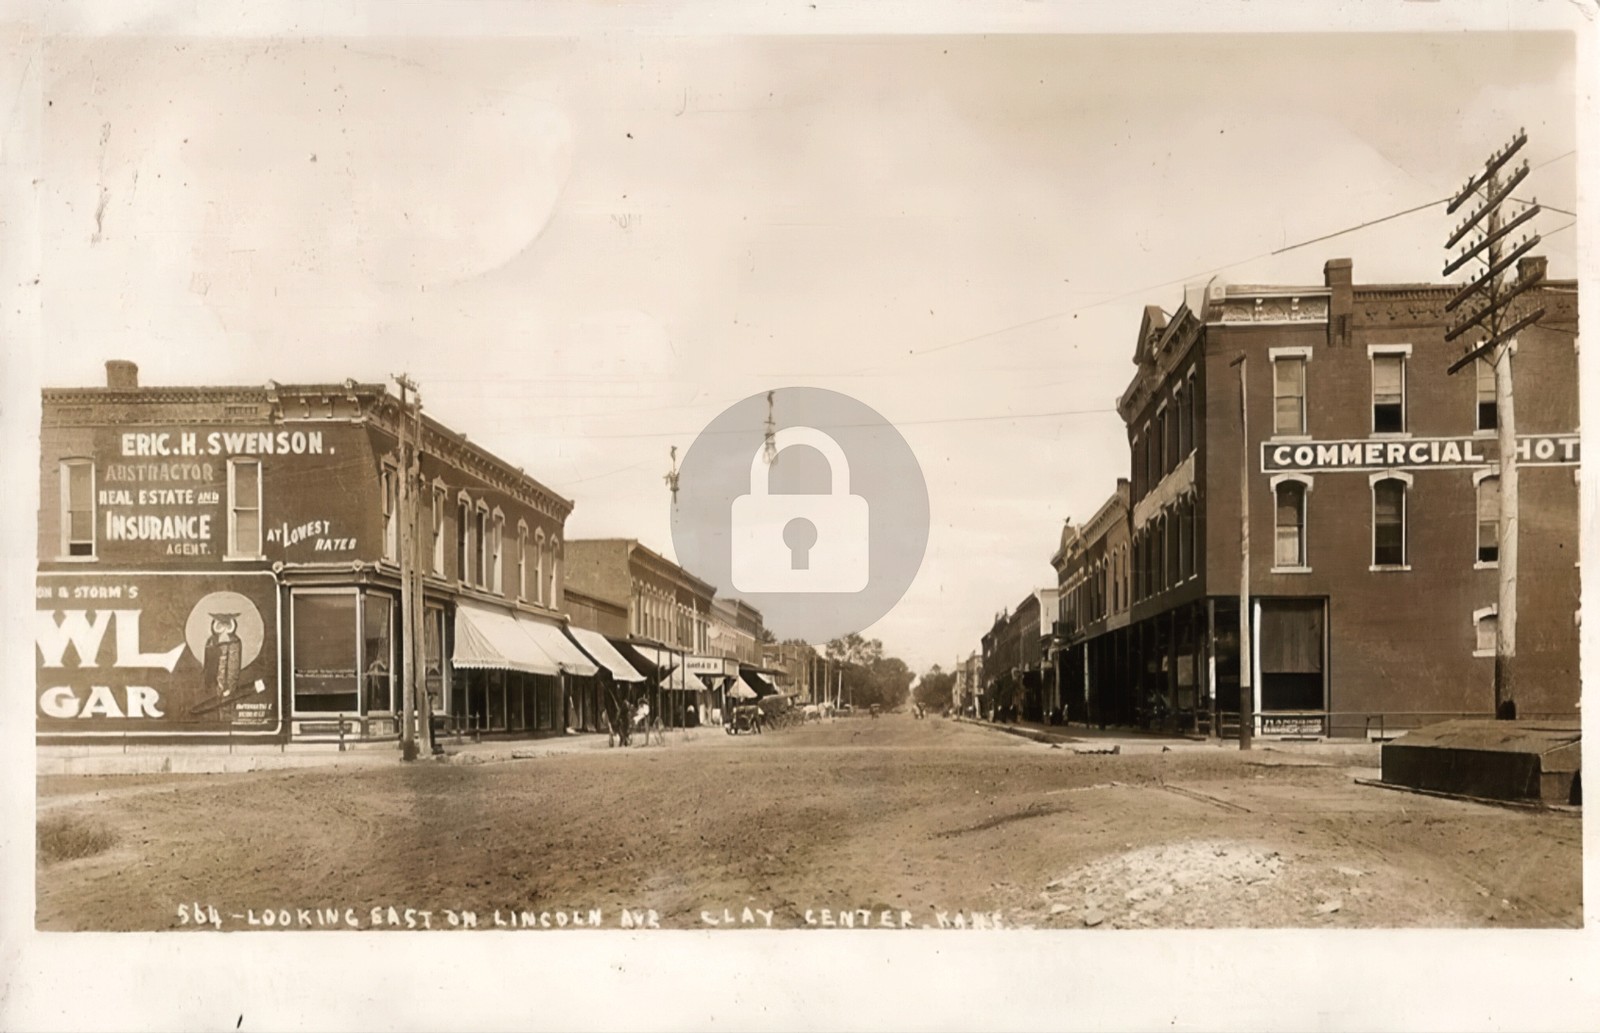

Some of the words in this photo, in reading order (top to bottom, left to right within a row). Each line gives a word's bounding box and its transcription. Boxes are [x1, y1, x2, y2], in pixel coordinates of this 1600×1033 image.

[1273, 440, 1484, 466] COMMERCIAL
[99, 490, 134, 505] REAL
[138, 489, 194, 505] ESTATE
[197, 491, 220, 504] AND
[266, 528, 282, 543] AT
[74, 583, 139, 599] STORM'S
[36, 609, 187, 674] WL
